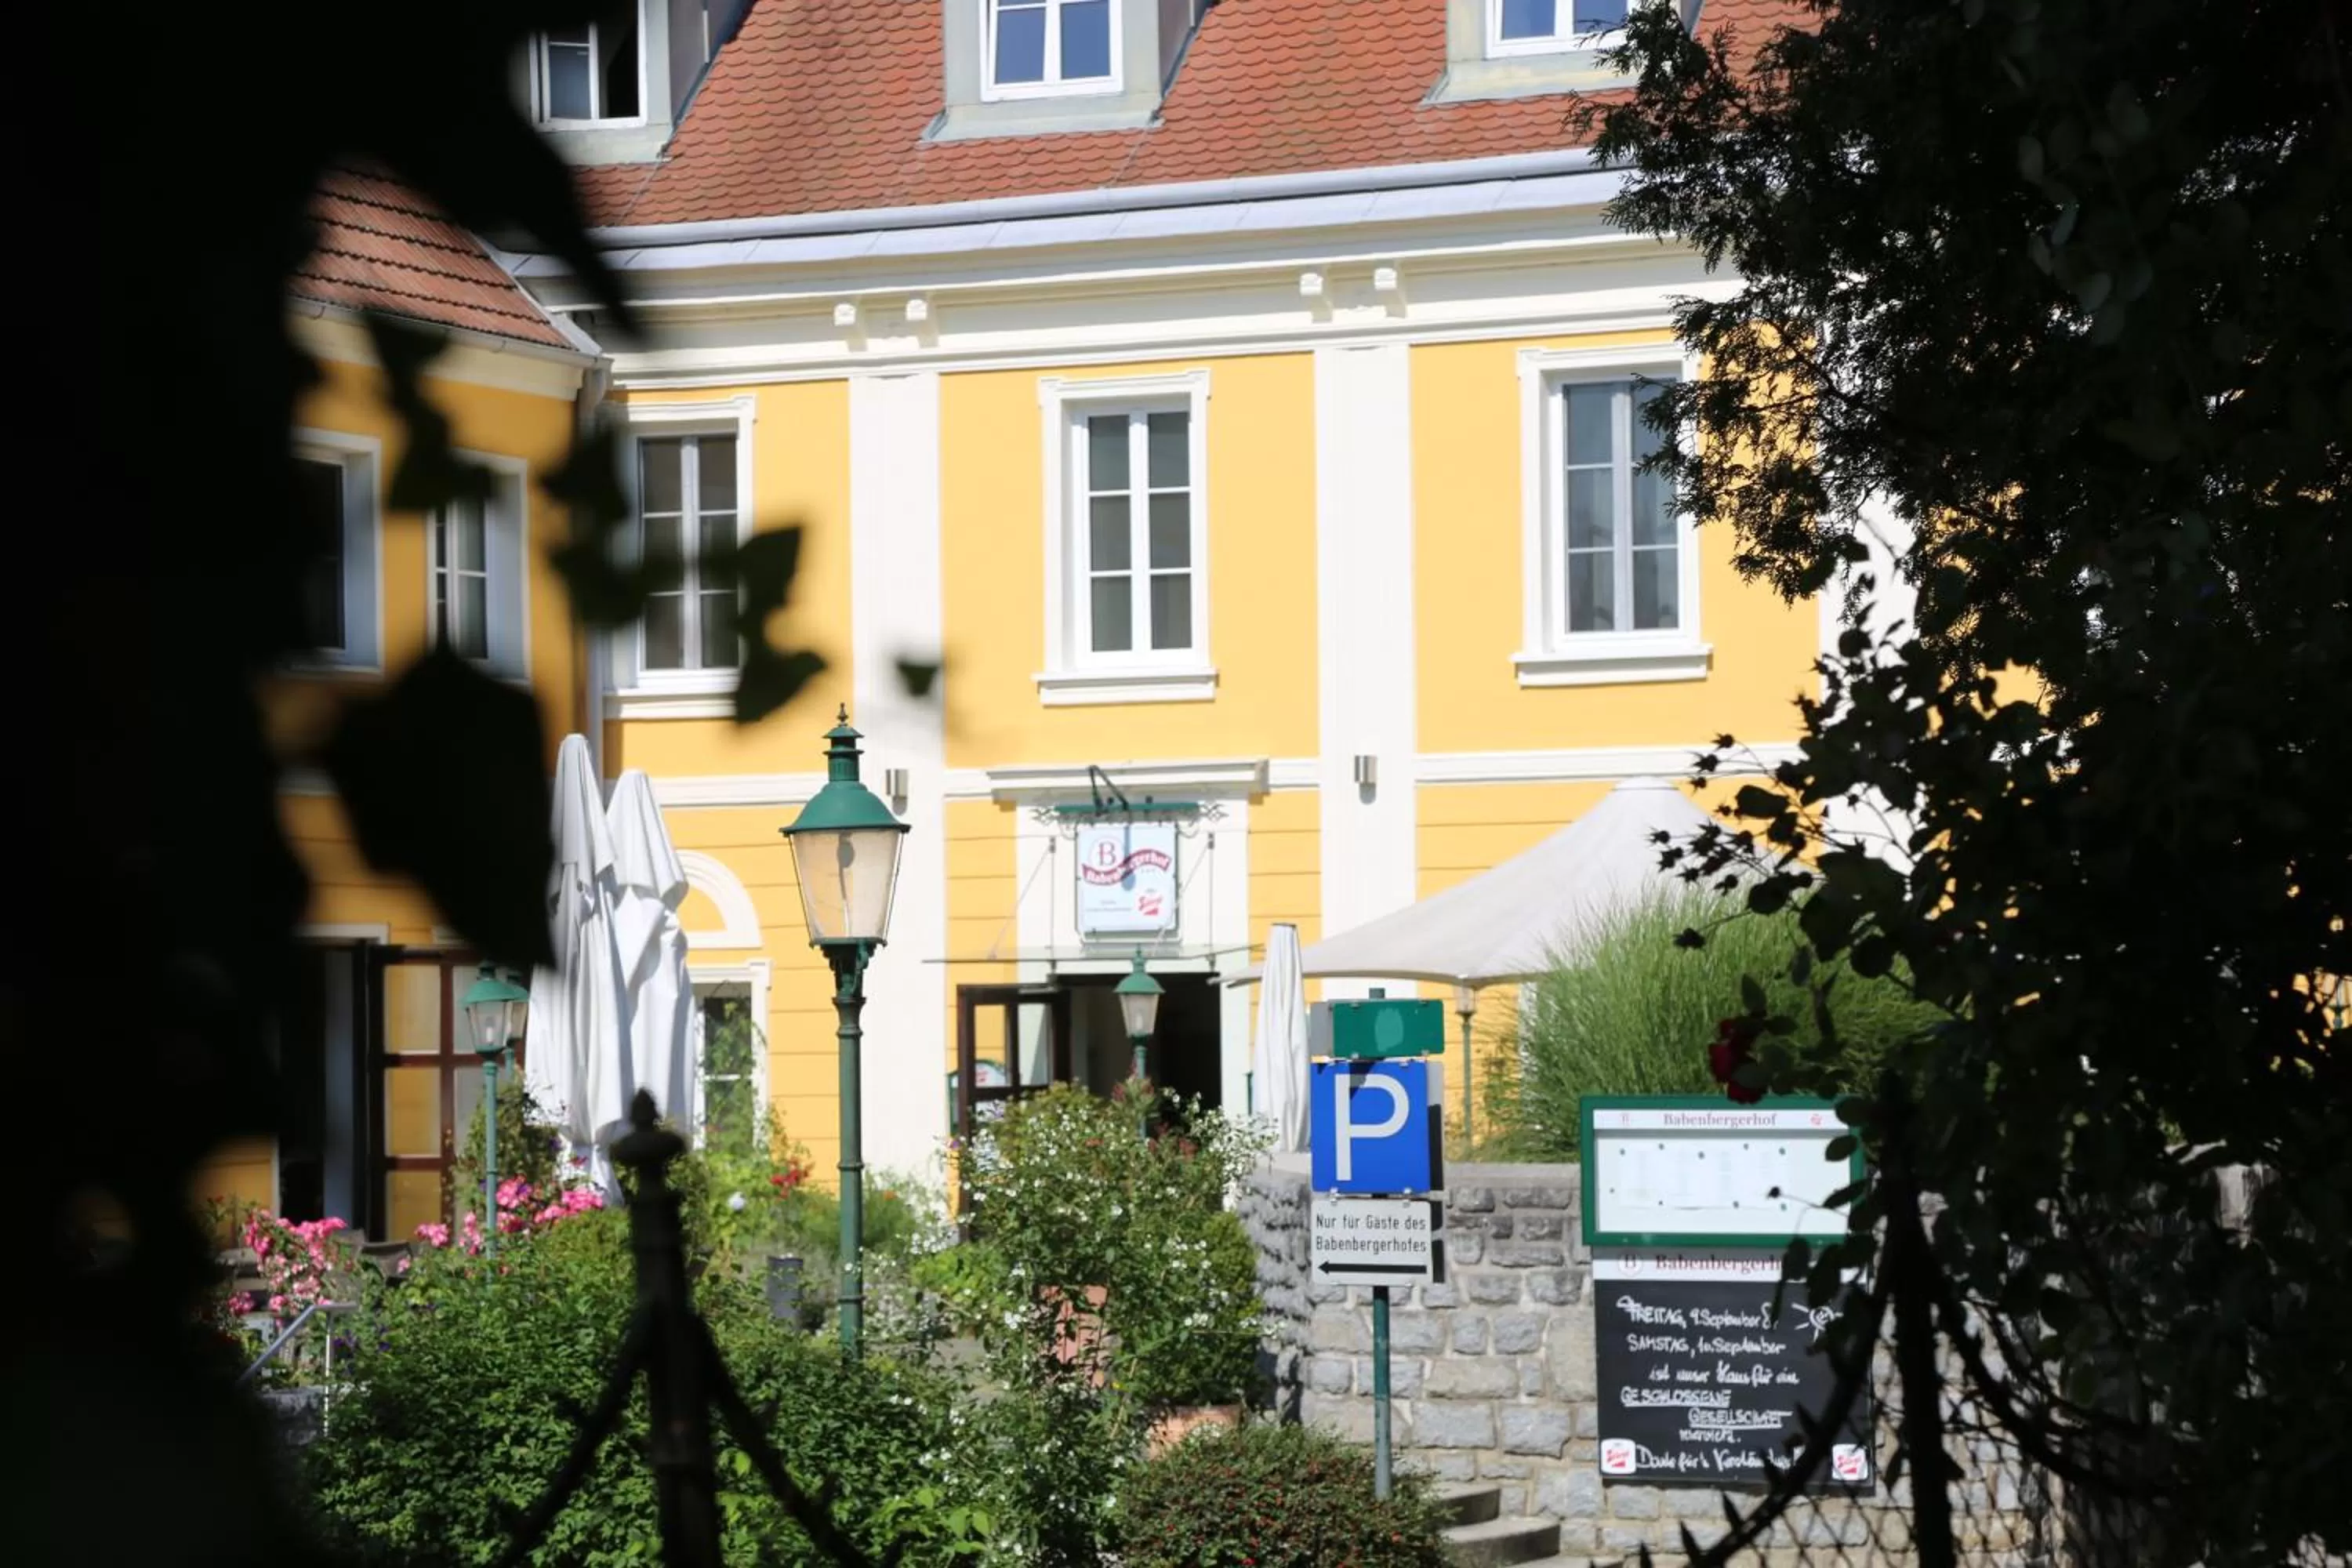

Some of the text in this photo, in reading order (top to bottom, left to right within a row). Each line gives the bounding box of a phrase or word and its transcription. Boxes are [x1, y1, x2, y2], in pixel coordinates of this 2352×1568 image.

[1098, 841, 1116, 866] B
[1335, 1074, 1410, 1181] P
[1663, 1112, 1777, 1128] Babenbergerhof
[1316, 1214, 1426, 1230] Nur für Gäste des
[1316, 1236, 1427, 1254] Babenbergerhofes
[1656, 1254, 1782, 1274] Babenbergerh
